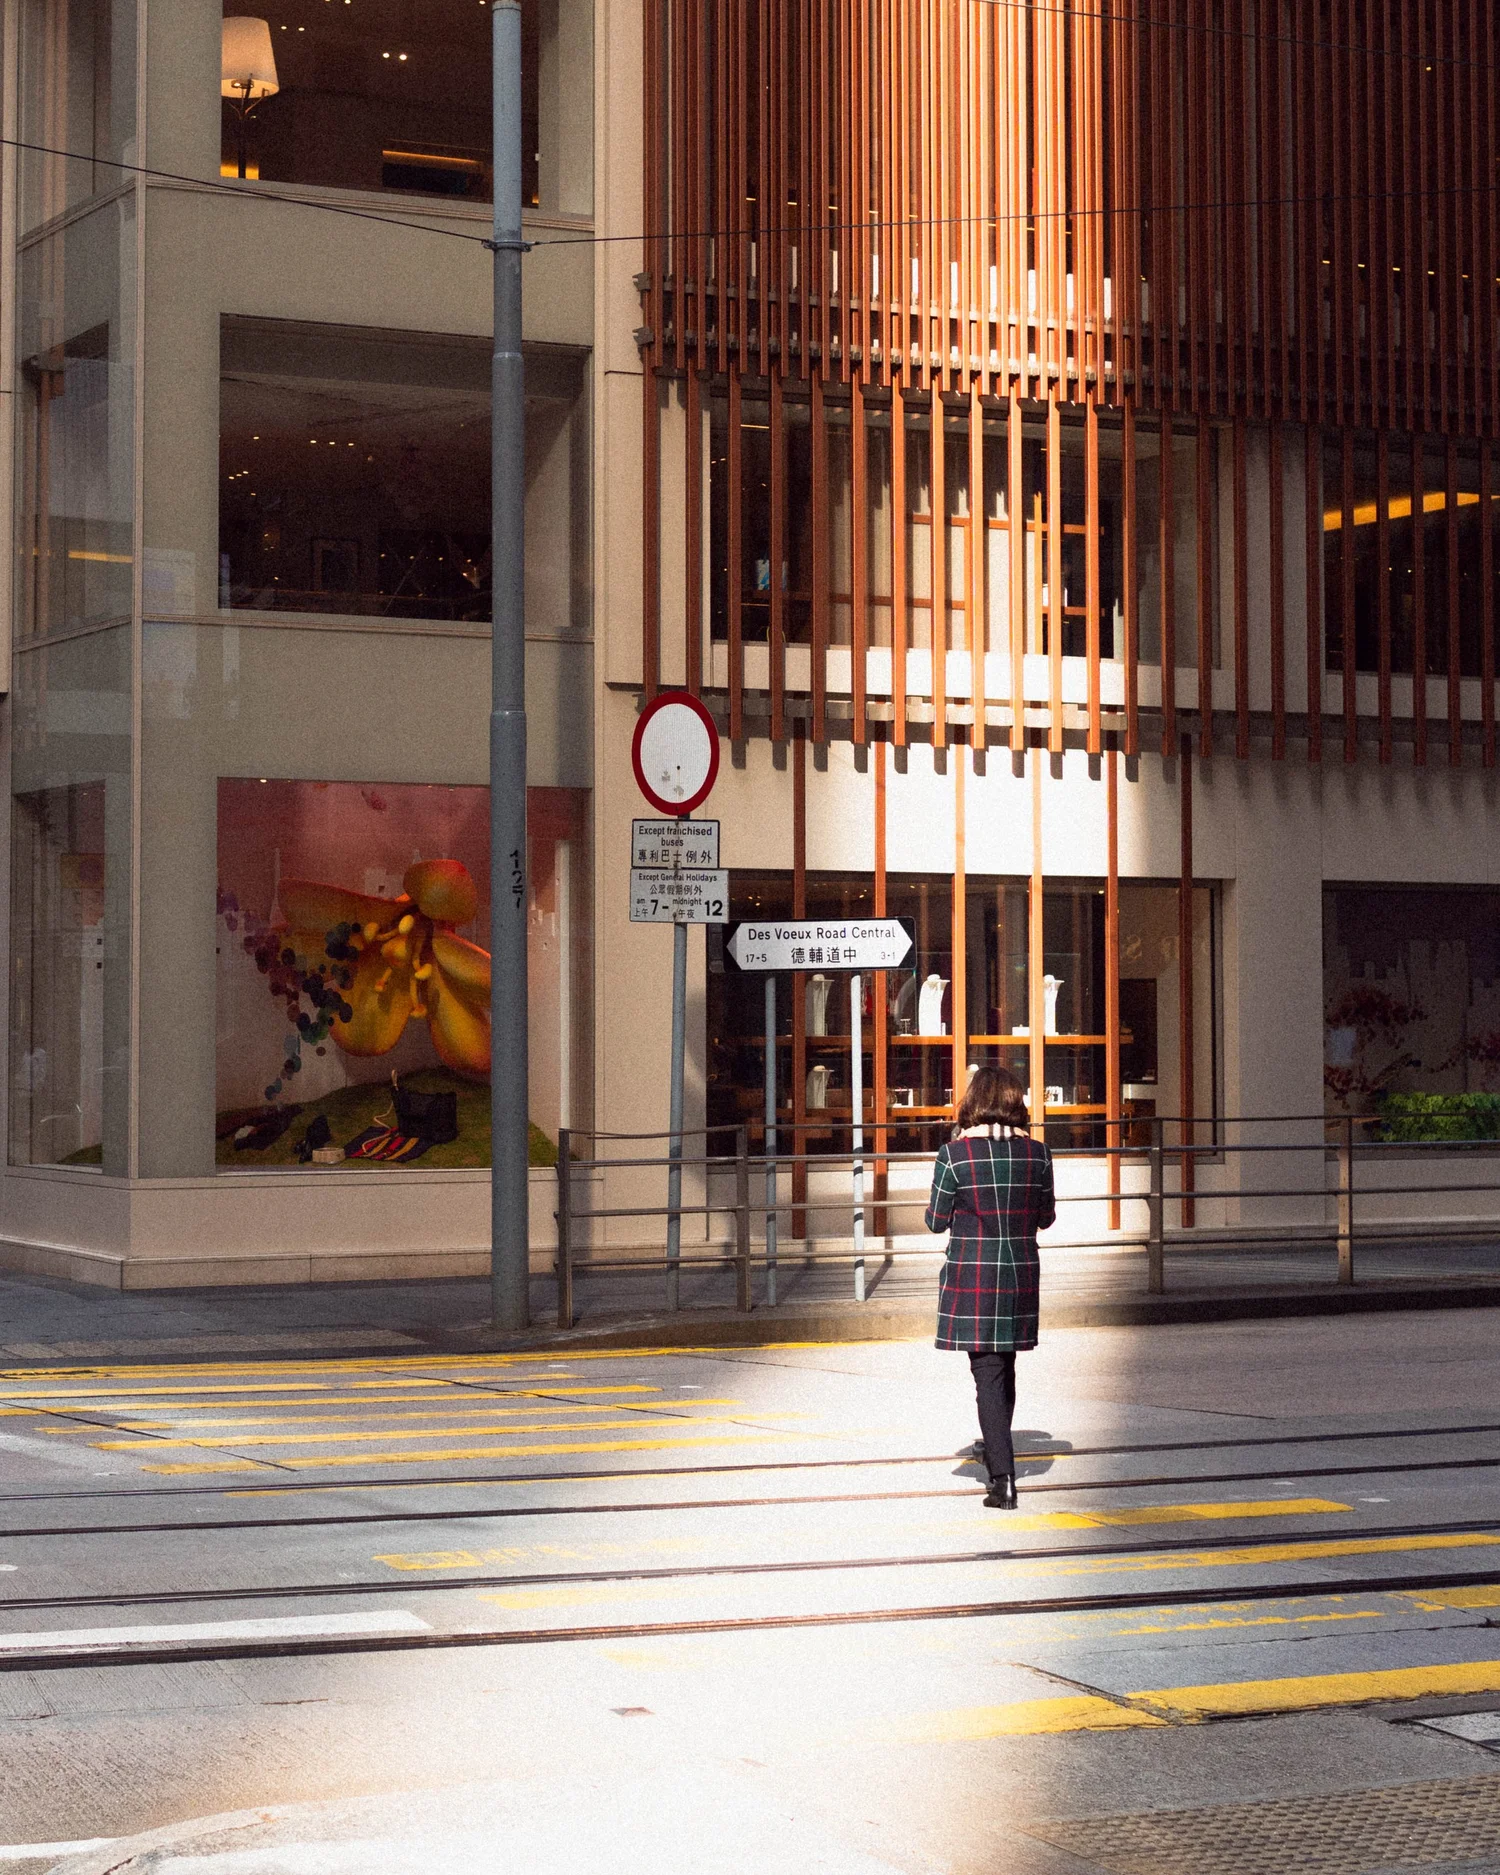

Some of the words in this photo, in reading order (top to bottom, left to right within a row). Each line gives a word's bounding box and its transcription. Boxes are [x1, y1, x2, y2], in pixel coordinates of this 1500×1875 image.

[638, 826, 665, 836] Except
[666, 826, 712, 836] franchised
[661, 838, 684, 846] buses
[638, 849, 712, 864] 專利巴士例外
[638, 873, 659, 881] Except
[686, 874, 717, 882] Holidays
[650, 884, 703, 896] 公眾假期例外
[672, 898, 702, 906] midnight
[704, 900, 723, 916] 12
[634, 908, 648, 918] 上午
[678, 909, 694, 918] 午夜
[748, 928, 770, 940] Des
[774, 928, 812, 940] Voeux
[816, 927, 846, 938] Road
[852, 926, 896, 938] Central
[746, 954, 767, 963] 17-5
[791, 946, 857, 964] 德輔道中
[880, 952, 896, 960] 3-1
